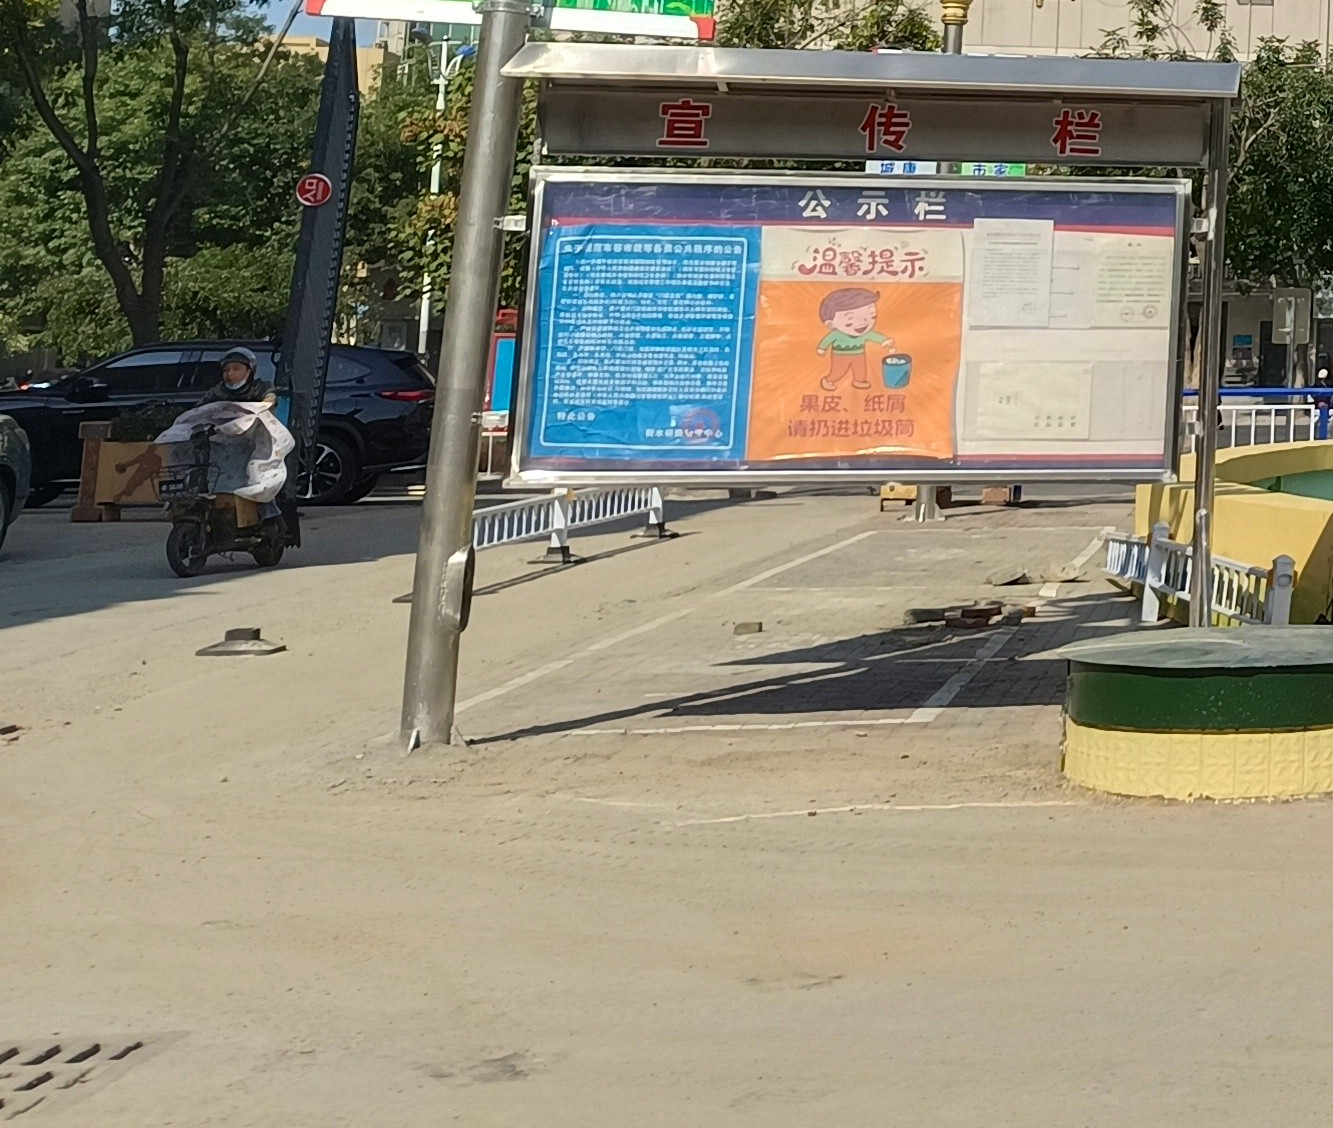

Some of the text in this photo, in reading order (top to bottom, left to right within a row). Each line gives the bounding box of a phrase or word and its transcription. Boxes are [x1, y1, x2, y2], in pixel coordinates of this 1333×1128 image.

[656, 99, 1102, 157] 宣传栏
[798, 189, 948, 221] 公示栏
[797, 245, 926, 279] 温馨提示
